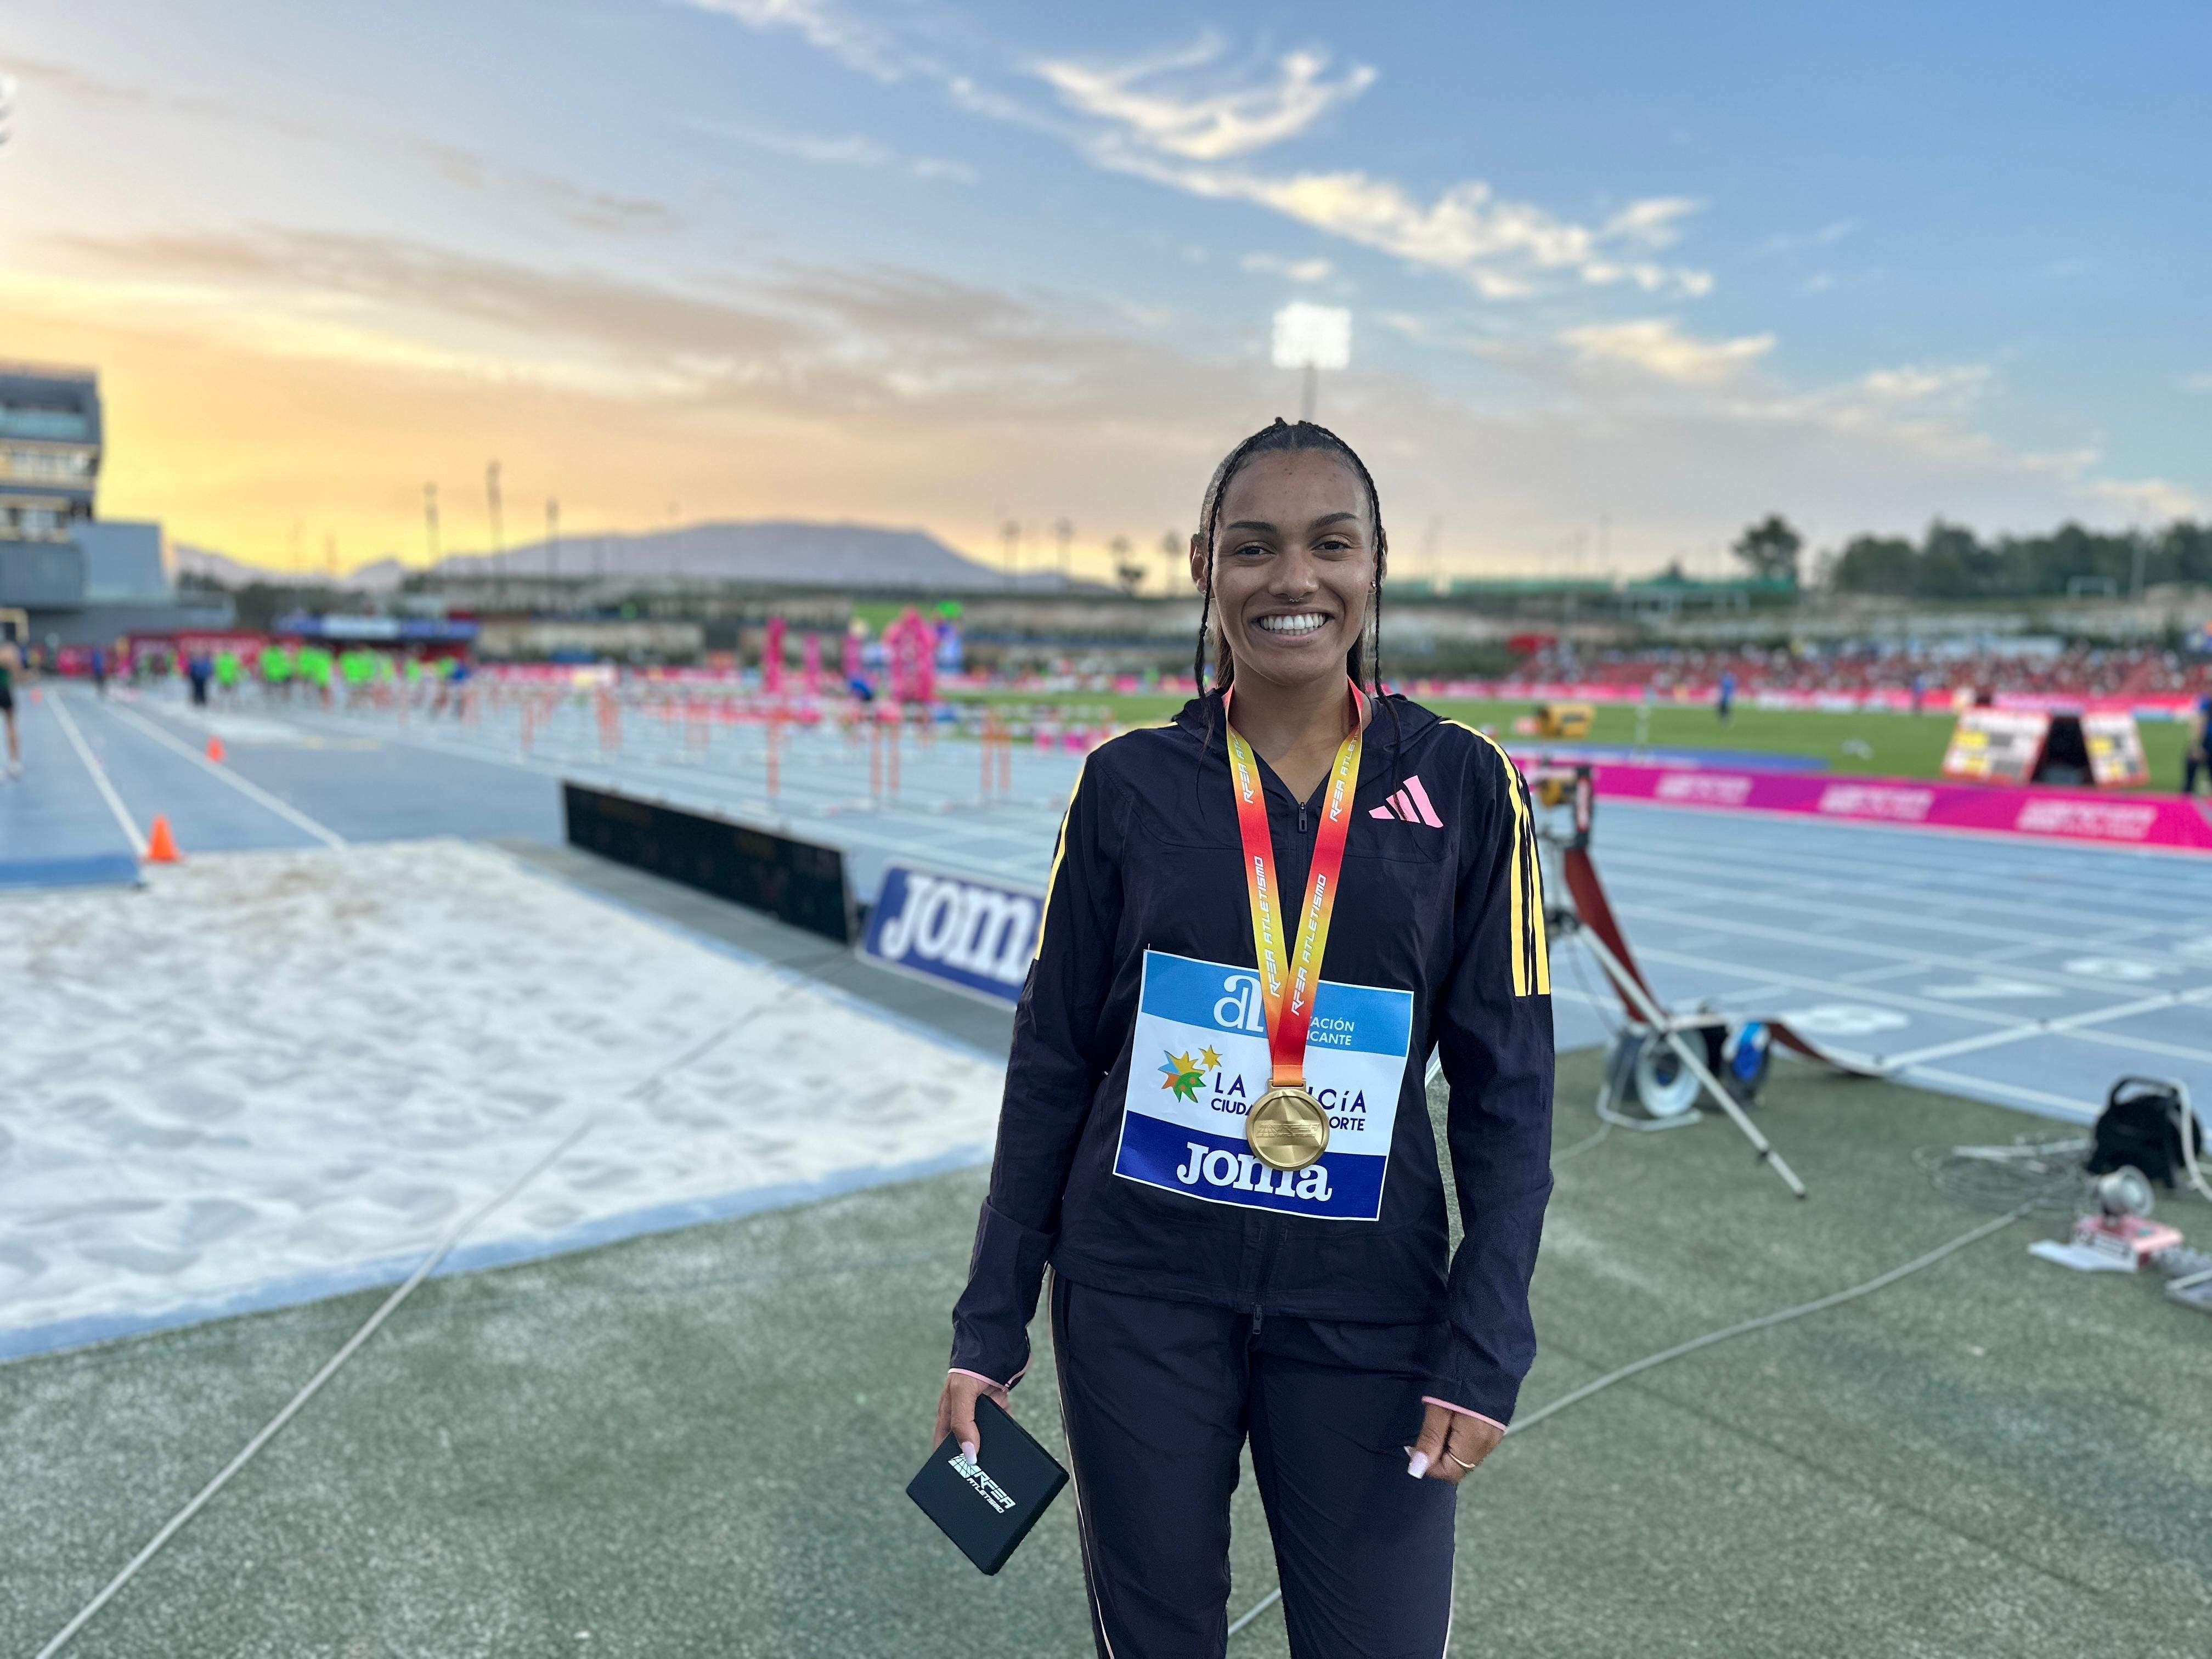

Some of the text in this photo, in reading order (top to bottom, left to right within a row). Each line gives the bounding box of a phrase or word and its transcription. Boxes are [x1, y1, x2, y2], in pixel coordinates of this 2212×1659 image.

[1329, 779, 1346, 822] RFEA
[880, 873, 1036, 985] Jom
[1254, 855, 1282, 998] RFEA ATLETISMO
[1291, 873, 1327, 1016] RFEA ATLETISMO
[1307, 1030, 1352, 1046] ICANTE
[1310, 1017, 1355, 1032] ACIÓN
[1215, 1071, 1246, 1098] LA
[1329, 1116, 1365, 1131] ORTE
[966, 1477, 1005, 1514] ATLETISMO
[974, 1471, 1016, 1509] RFEA
